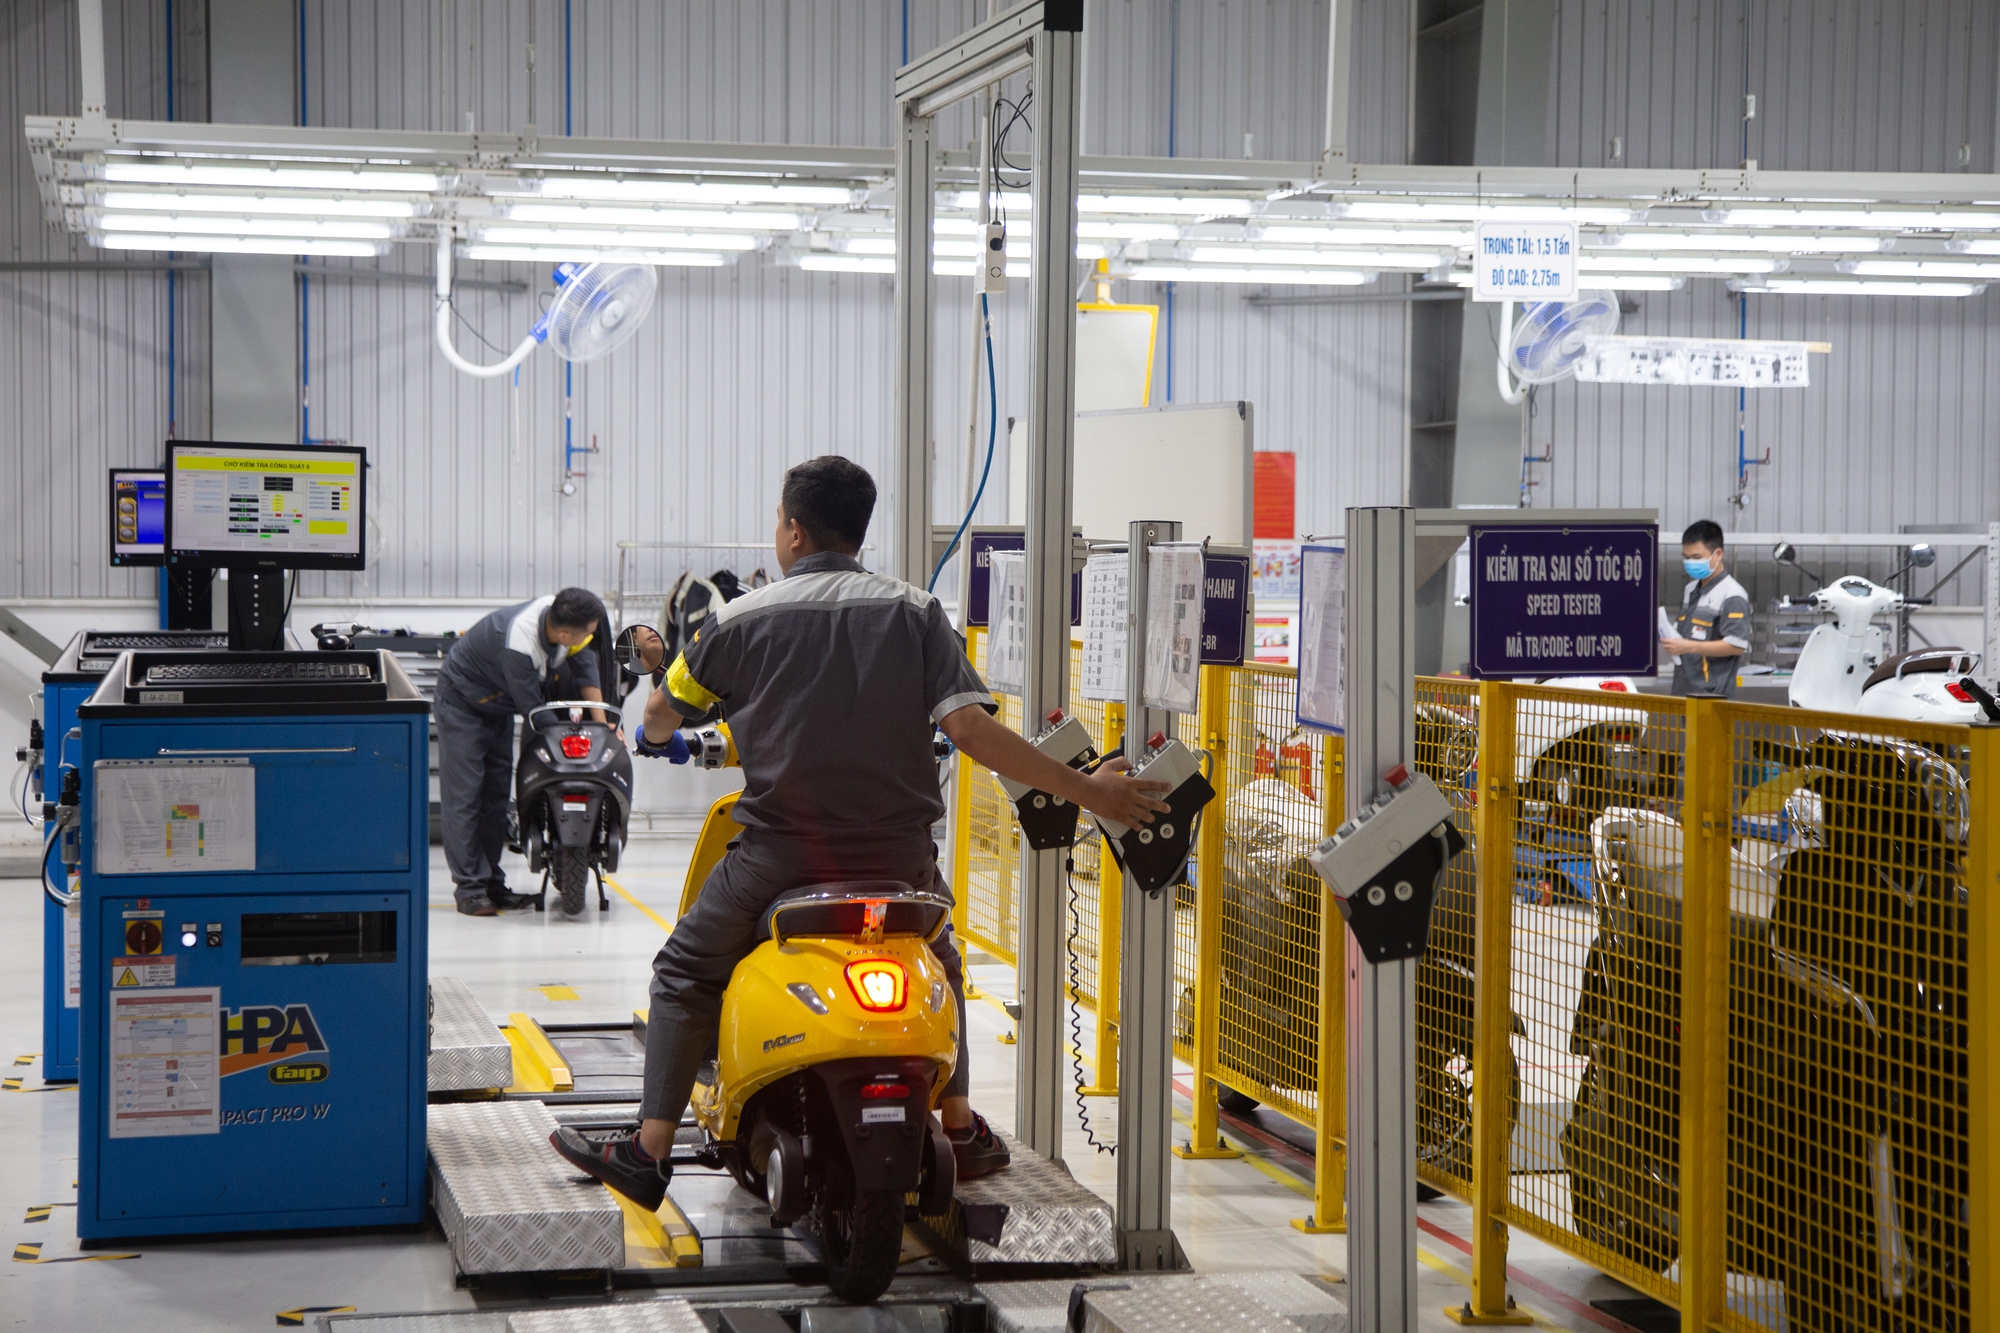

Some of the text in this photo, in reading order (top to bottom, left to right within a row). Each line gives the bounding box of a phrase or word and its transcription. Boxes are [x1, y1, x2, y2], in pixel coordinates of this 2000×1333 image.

[1483, 229, 1570, 259] TRỌNG TẢI: 1,5 Tấn
[1492, 264, 1560, 290] ĐỘ CAO: 2,75m
[976, 544, 991, 568] KIỂ
[1486, 544, 1643, 587] KIỂM TRA SAI SỐ TỐC ĐỘ
[1204, 577, 1236, 600] HANH
[1527, 594, 1602, 616] SPEED TESTER
[1506, 631, 1622, 660] MÃ TB/CODE: OUT-SPD
[220, 1004, 329, 1056] HPA
[220, 1102, 331, 1126] PACT PRO W
